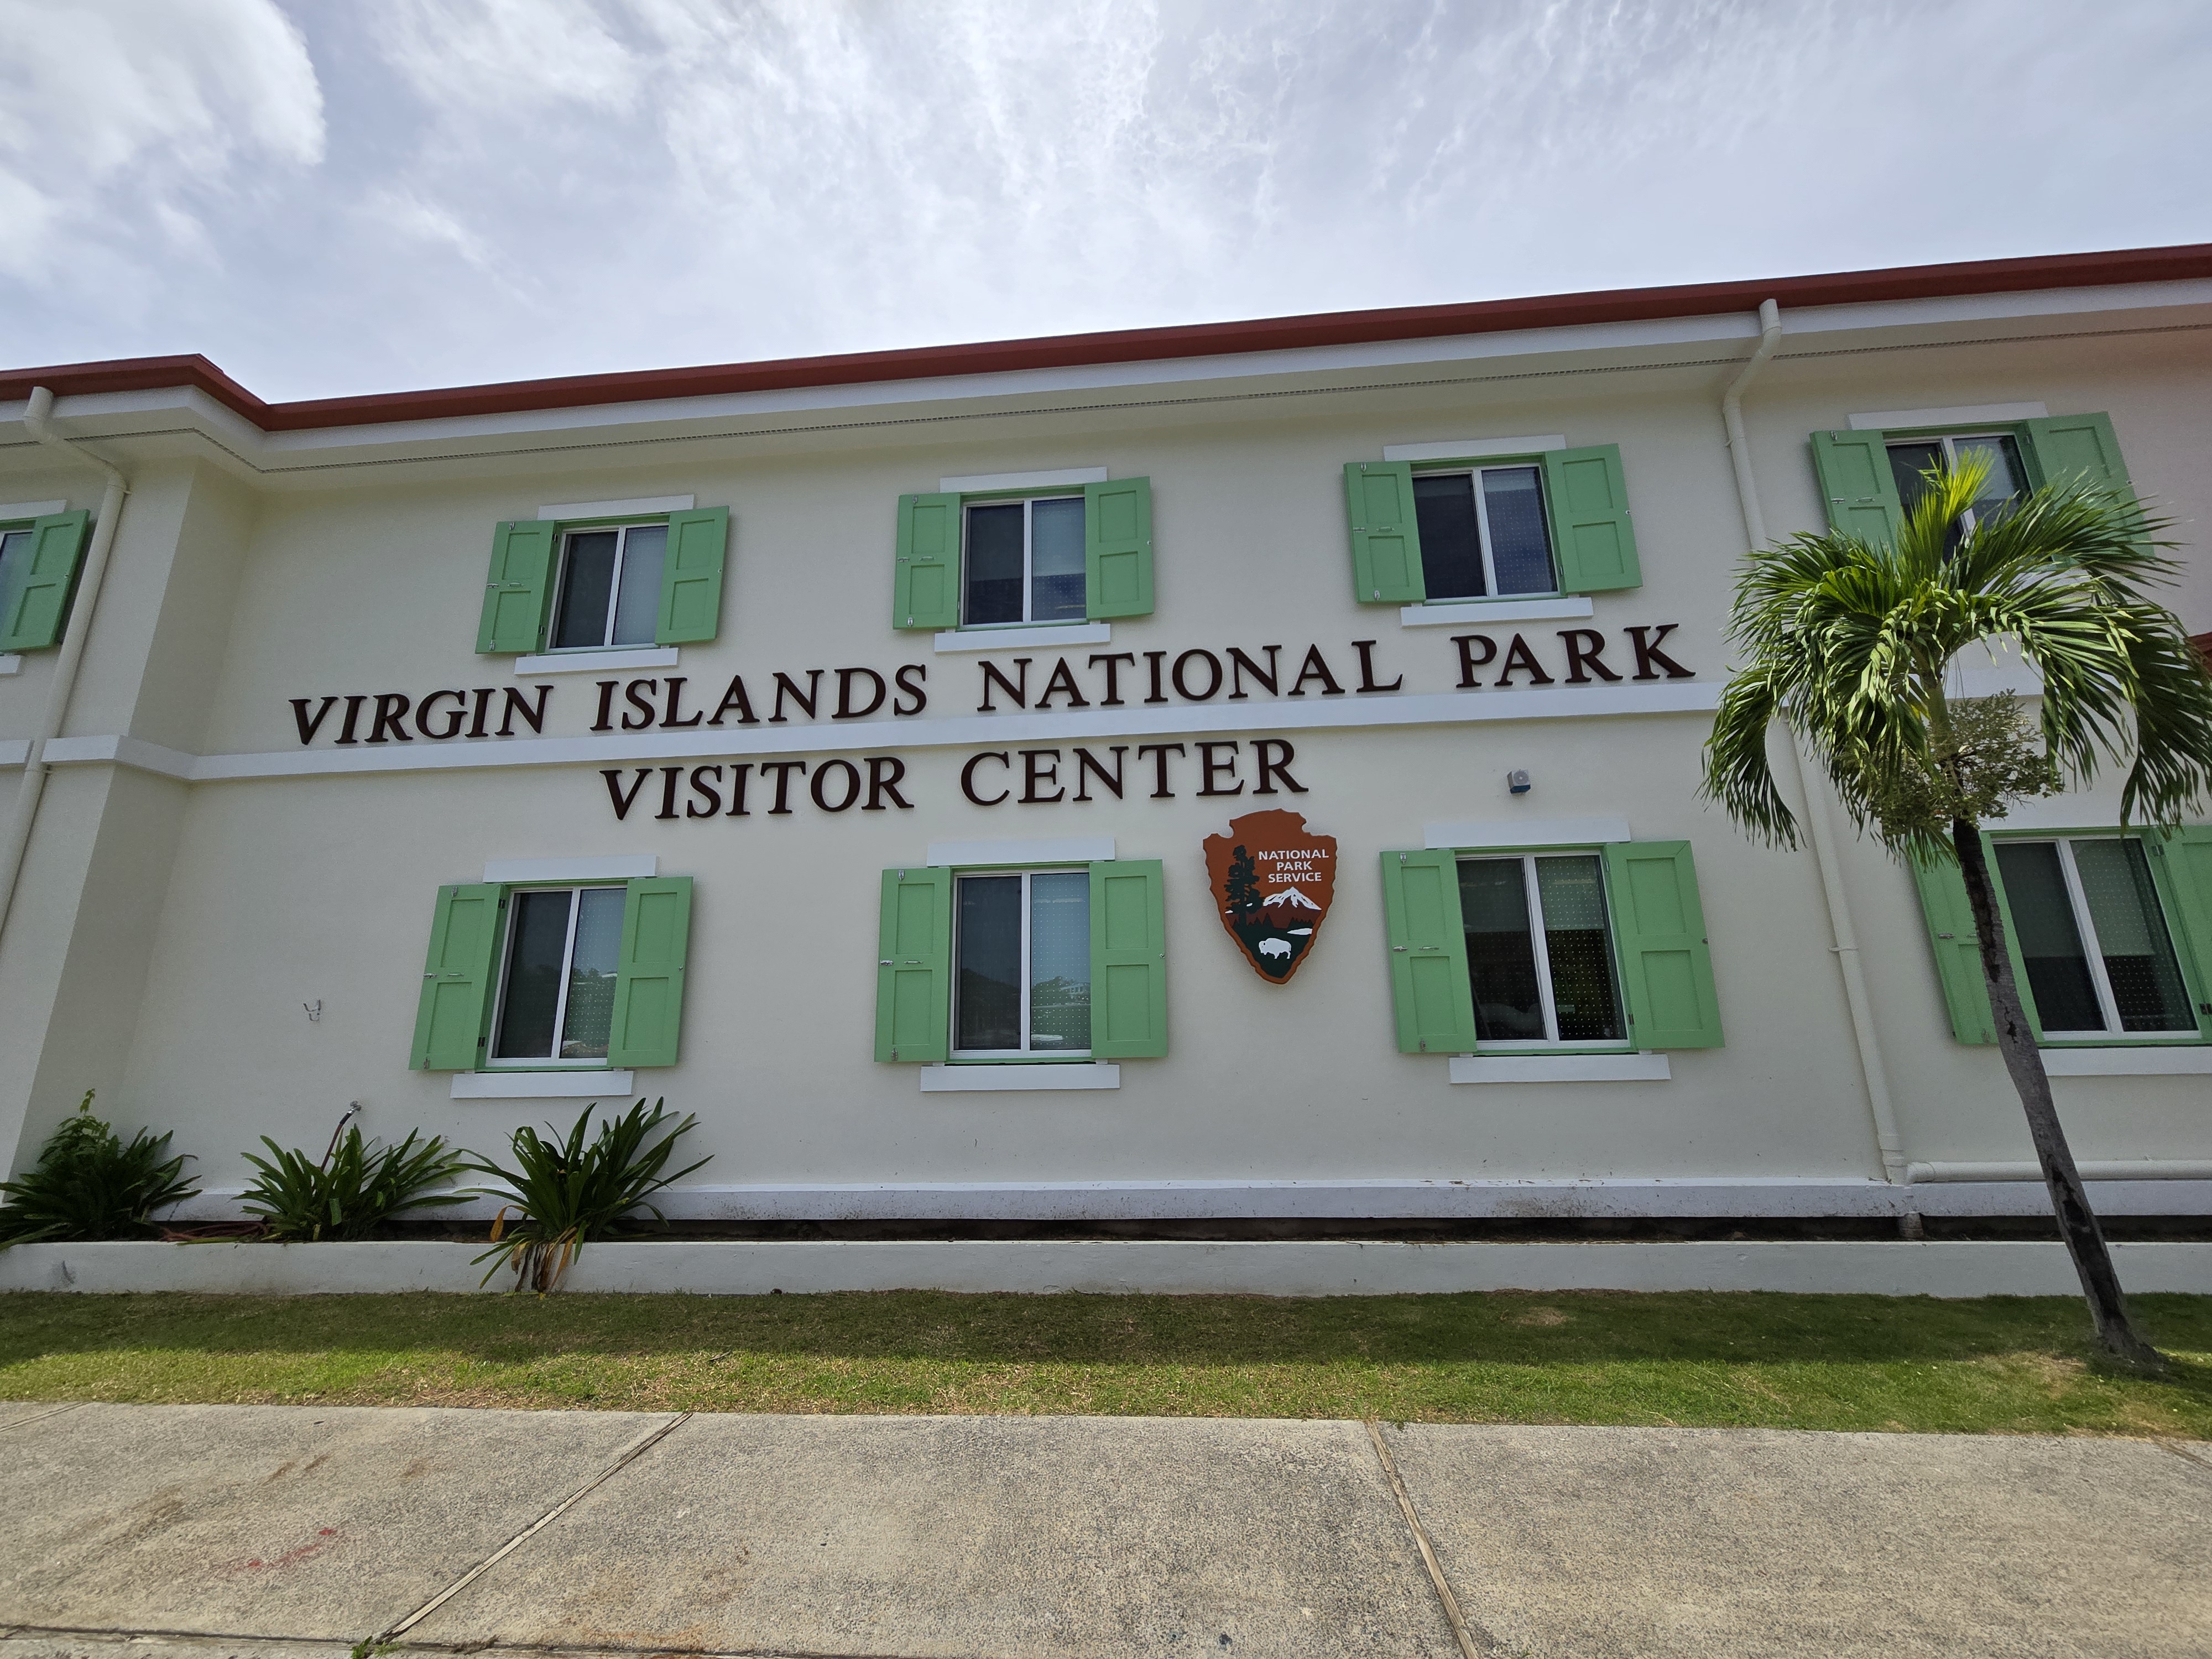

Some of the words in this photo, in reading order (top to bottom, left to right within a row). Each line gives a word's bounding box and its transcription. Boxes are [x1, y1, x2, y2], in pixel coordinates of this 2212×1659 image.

[288, 684, 554, 745] VIRGIN
[589, 664, 927, 732] ISLANDS
[976, 639, 1404, 712] NATIONAL
[1449, 623, 1697, 689] PARK
[598, 756, 915, 821] VISITOR
[960, 738, 1310, 807] CENTER
[1258, 849, 1329, 860] NATIONAL
[1276, 860, 1313, 871] PARK
[1267, 872, 1322, 883] SERVICE
